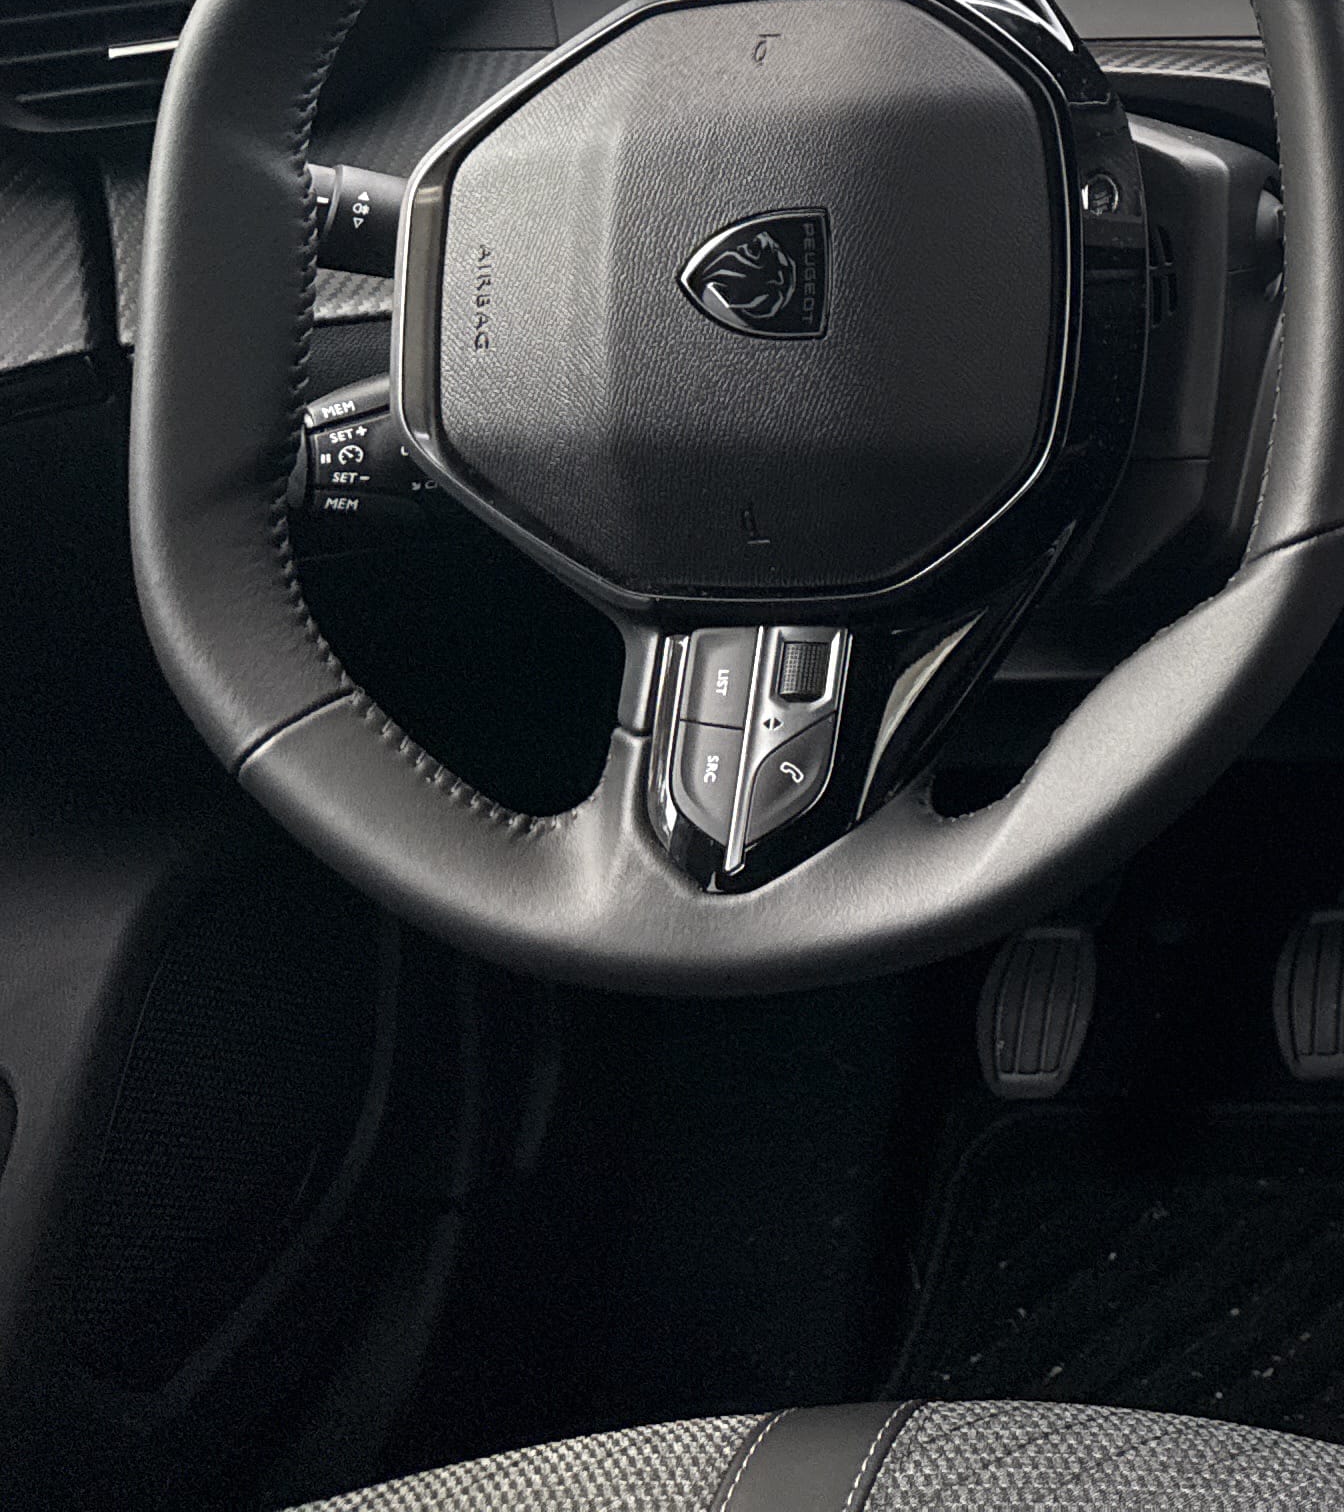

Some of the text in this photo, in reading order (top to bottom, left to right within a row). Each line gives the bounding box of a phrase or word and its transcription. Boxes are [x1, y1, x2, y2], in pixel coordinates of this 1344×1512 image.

[803, 223, 815, 325] PEUGEOT
[473, 244, 491, 353] AIRBAG
[322, 401, 355, 418] MEM
[325, 497, 359, 511] MEM
[715, 669, 730, 696] LIST
[703, 755, 719, 783] SRC
